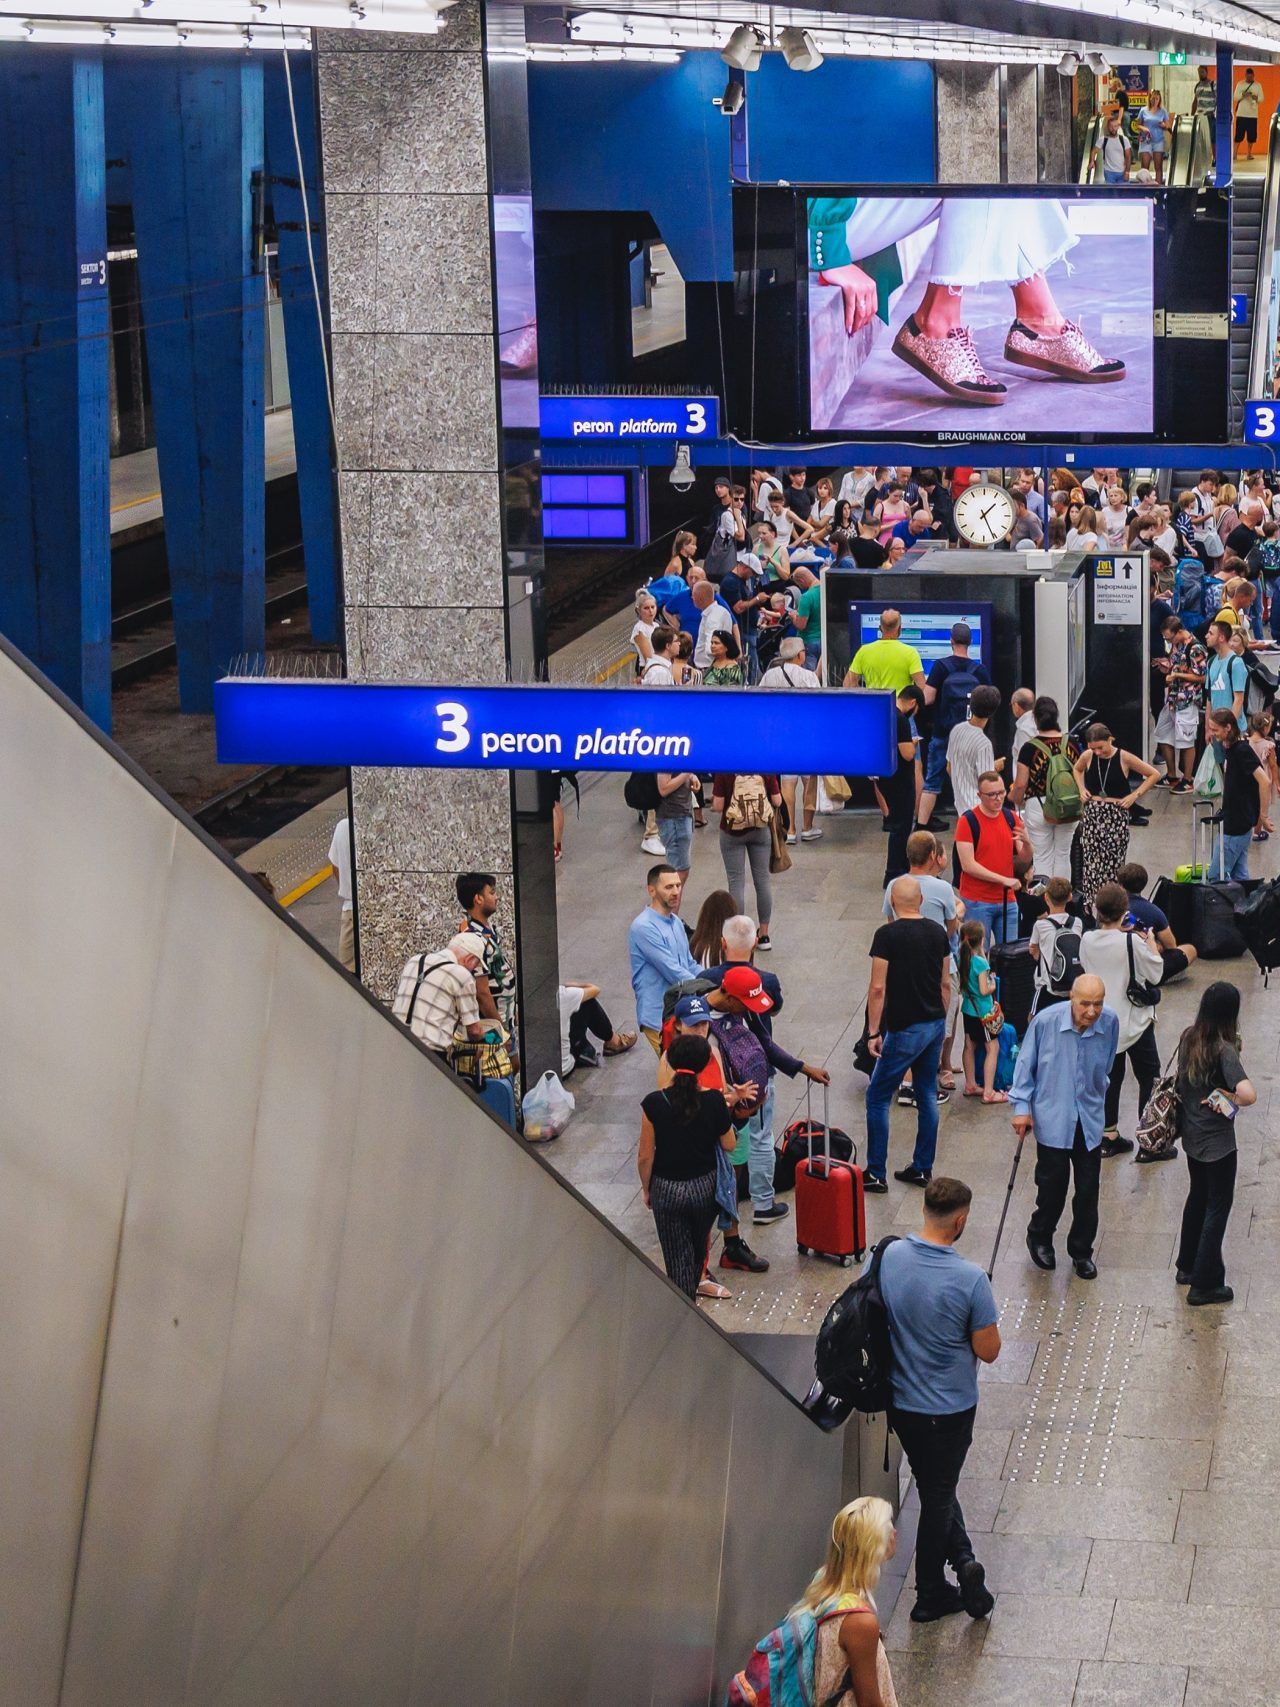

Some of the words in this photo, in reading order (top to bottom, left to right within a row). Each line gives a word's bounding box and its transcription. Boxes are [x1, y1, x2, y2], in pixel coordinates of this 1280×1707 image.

[80, 263, 98, 274] SEKTOR
[99, 260, 106, 285] 3
[573, 421, 614, 437] peron
[619, 418, 678, 437] platform
[685, 403, 706, 434] 3
[1254, 407, 1275, 437] 3
[937, 432, 1026, 441] BRAUGHMAN.COM
[436, 702, 471, 752] 3
[481, 732, 562, 758] peron
[574, 728, 691, 760] platform
